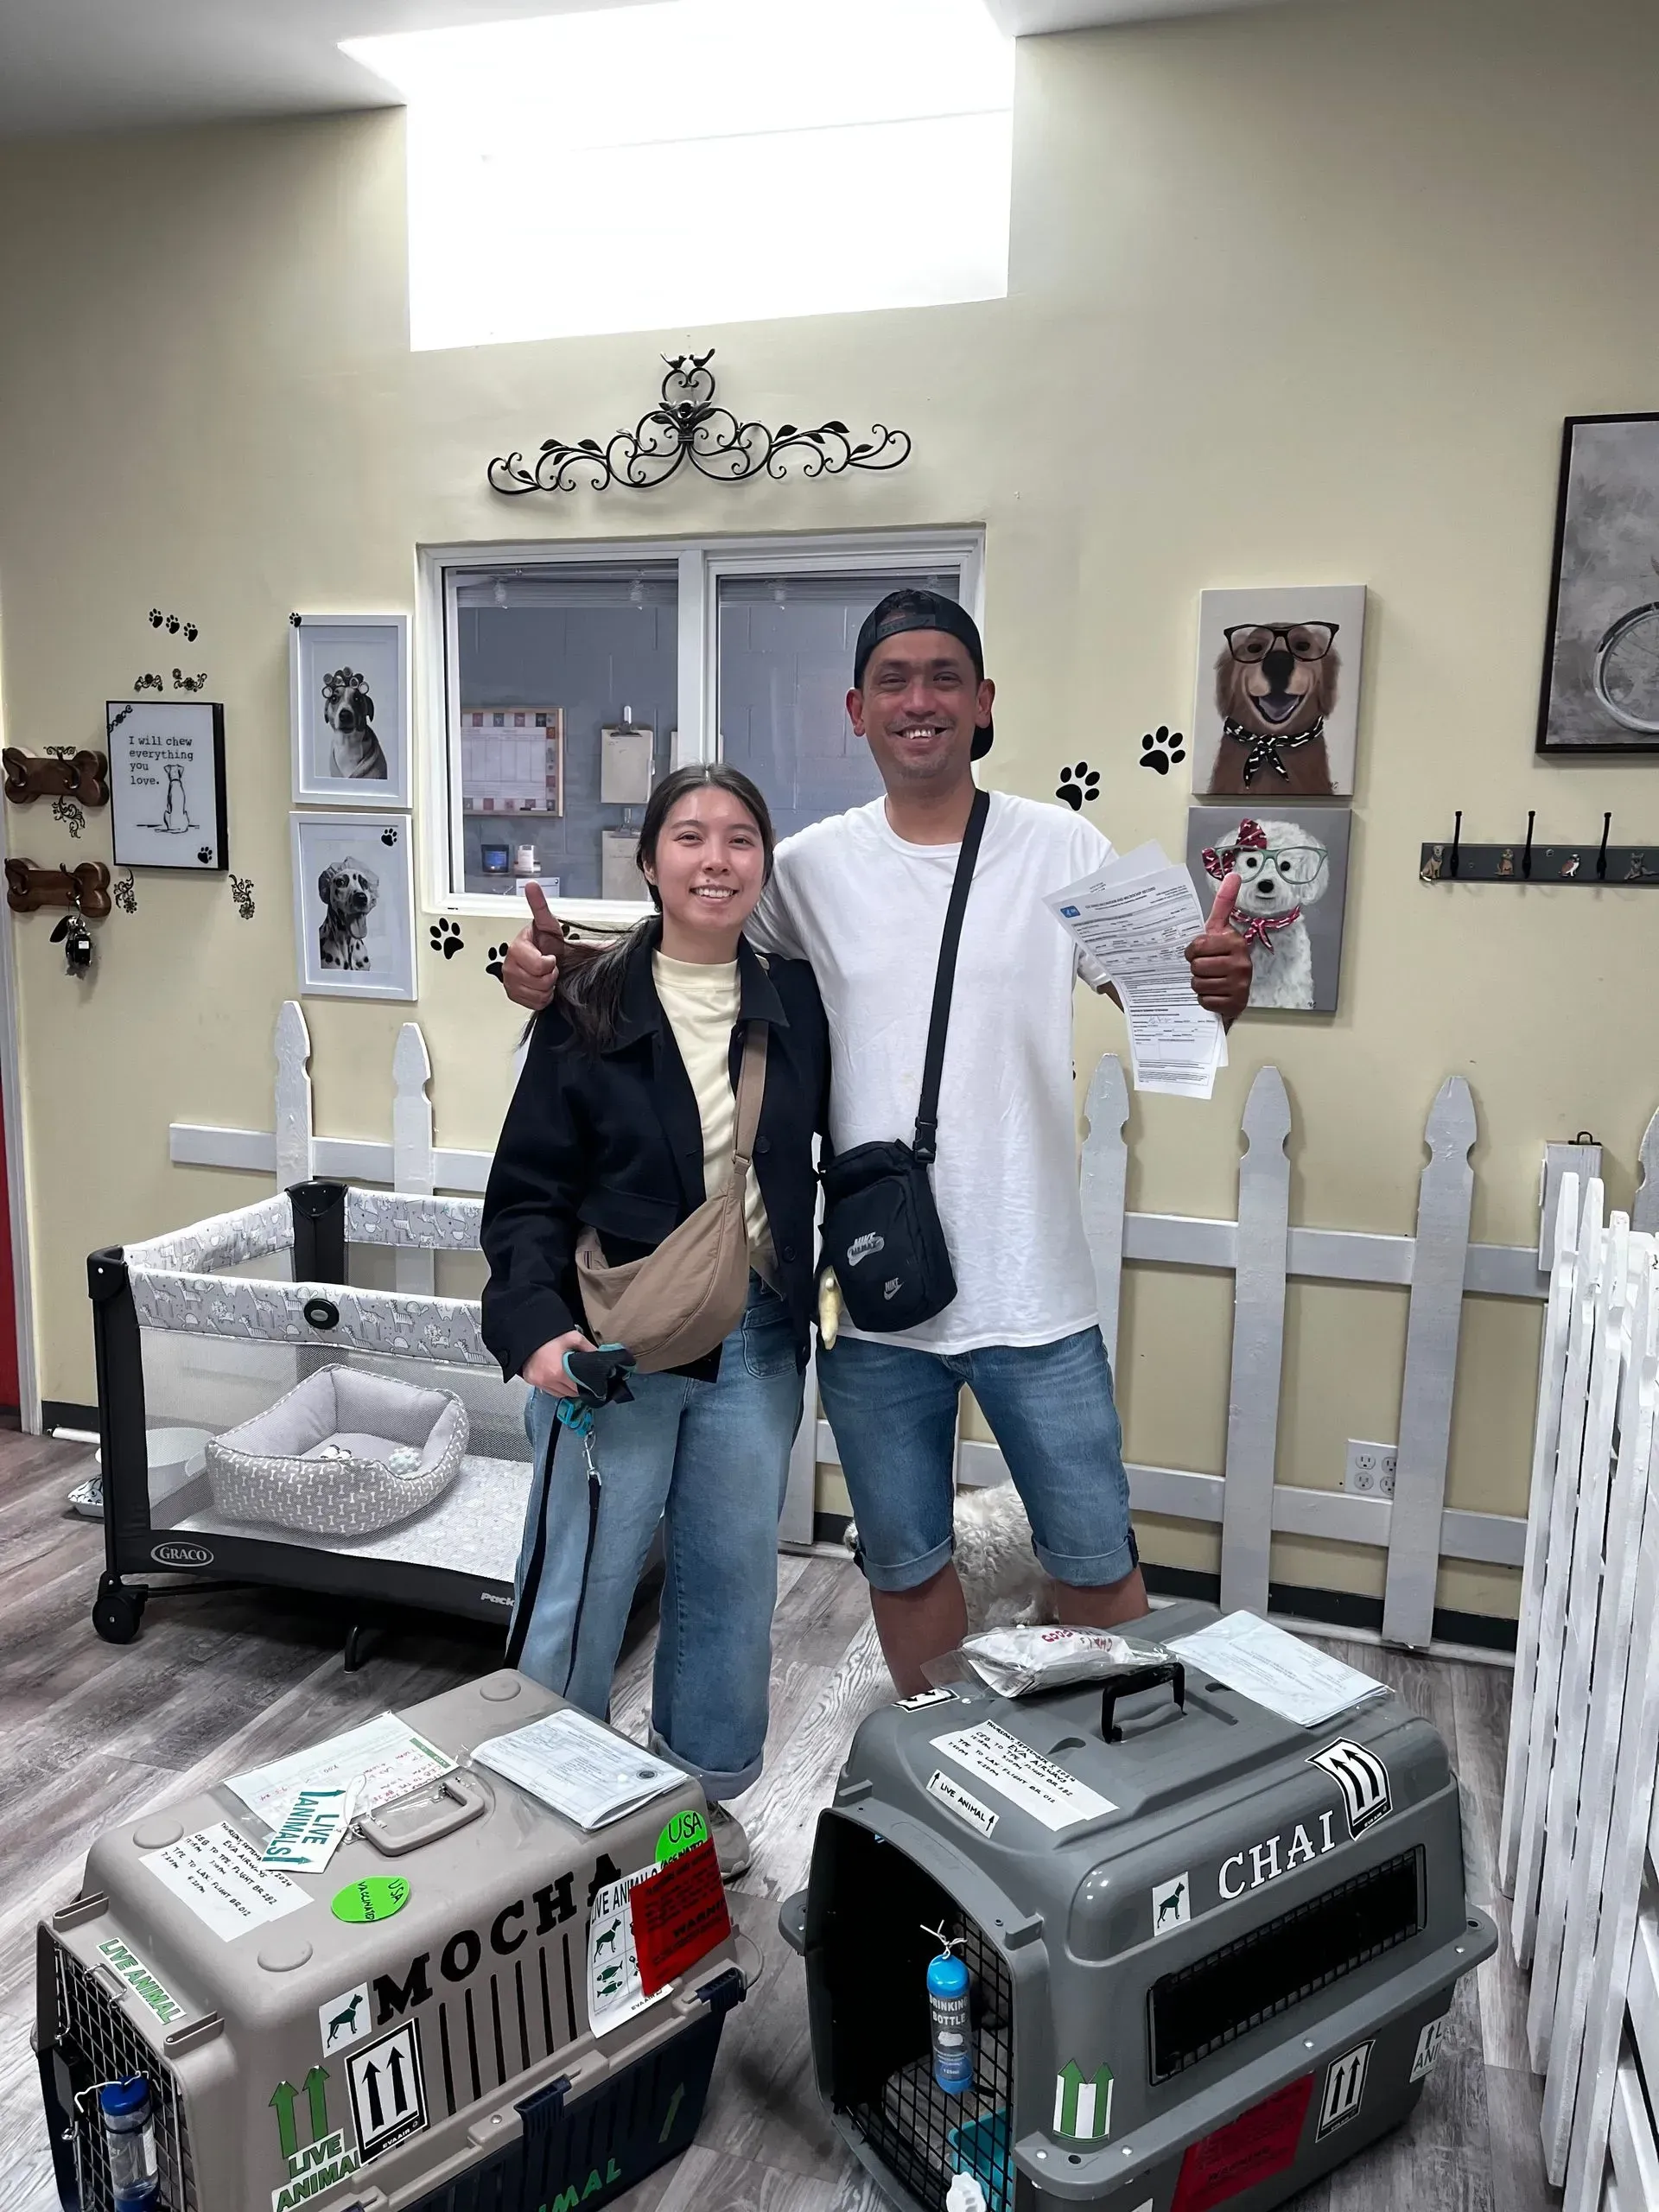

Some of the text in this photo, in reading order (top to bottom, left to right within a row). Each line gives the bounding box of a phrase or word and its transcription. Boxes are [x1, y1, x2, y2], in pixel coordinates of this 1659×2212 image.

[129, 735, 193, 747] I will chew
[129, 749, 194, 761] everything
[130, 762, 149, 772] you
[130, 776, 160, 785] love.
[159, 1547, 207, 1561] GRACO
[976, 1731, 991, 1743] CEB
[1007, 1744, 1067, 1783] EVA AIRWAYS
[1002, 1768, 1027, 1784] FLIGHT
[1028, 1785, 1041, 1795] BR
[940, 1782, 985, 1822] LIVE ANIMAL
[266, 1797, 319, 1856] ANIMALS
[302, 1814, 340, 1846] LIVE
[668, 1812, 703, 1844] USA
[223, 1840, 238, 1853] EVA
[1218, 1810, 1336, 1899] CHAI
[194, 1834, 210, 1847] CEB
[232, 1866, 255, 1885] FLIGHT
[252, 1885, 264, 1895] BR
[174, 1847, 187, 1859] TPE
[188, 1859, 196, 1868] TO
[212, 1881, 232, 1899] FLIGHT
[229, 1897, 240, 1909] BR
[238, 1906, 252, 1917] 012
[274, 1872, 293, 1888] 2024
[388, 1878, 404, 1904] USA
[373, 1853, 621, 2025] MOCHA
[99, 1939, 180, 2024] LIVE ANIMAL
[929, 1993, 968, 2012] DRINKING
[932, 2011, 966, 2026] BOTTLE
[289, 2133, 341, 2179] LIVE
